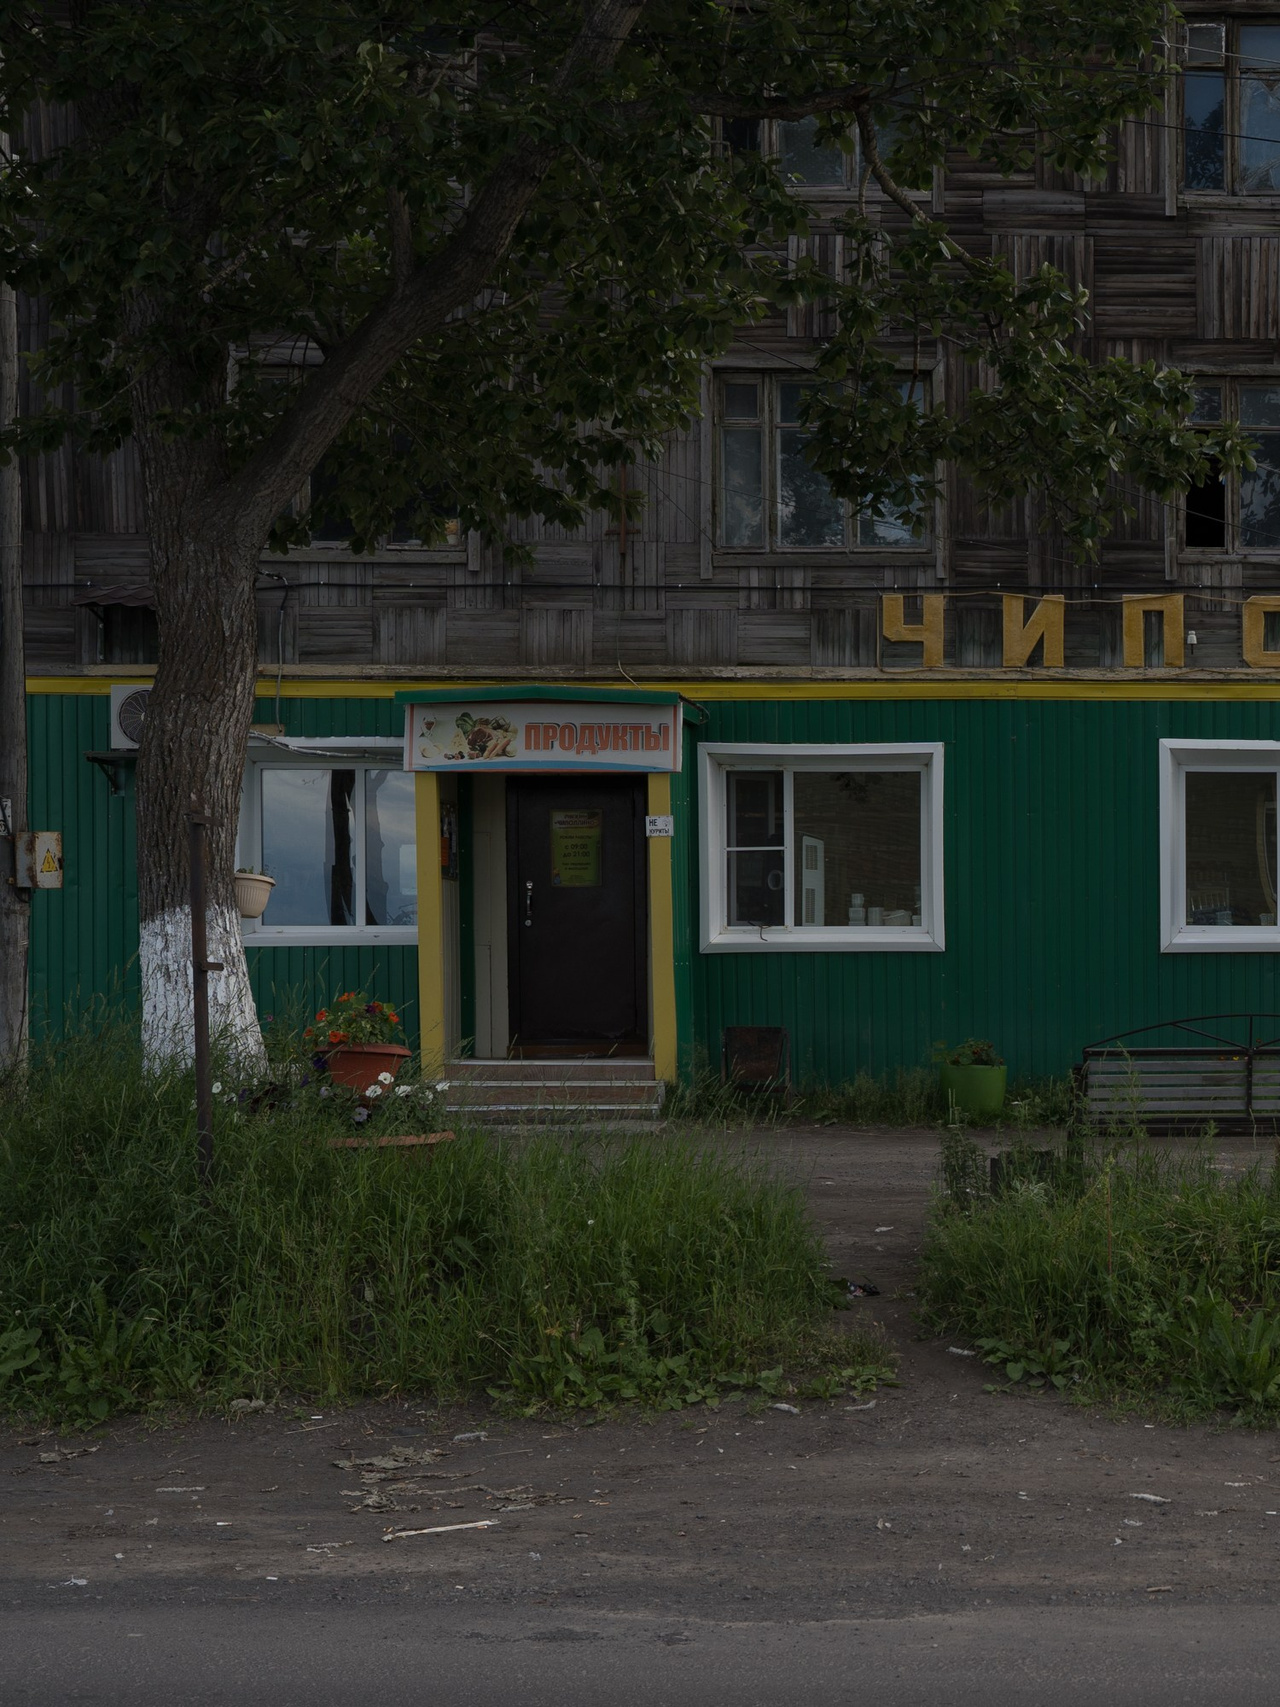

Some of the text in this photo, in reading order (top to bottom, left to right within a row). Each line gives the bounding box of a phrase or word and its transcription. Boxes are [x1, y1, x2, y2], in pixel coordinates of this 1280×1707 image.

[523, 722, 670, 755] ПРОДУКТЫ
[648, 818, 658, 827] НЕ
[572, 850, 590, 858] 21:00
